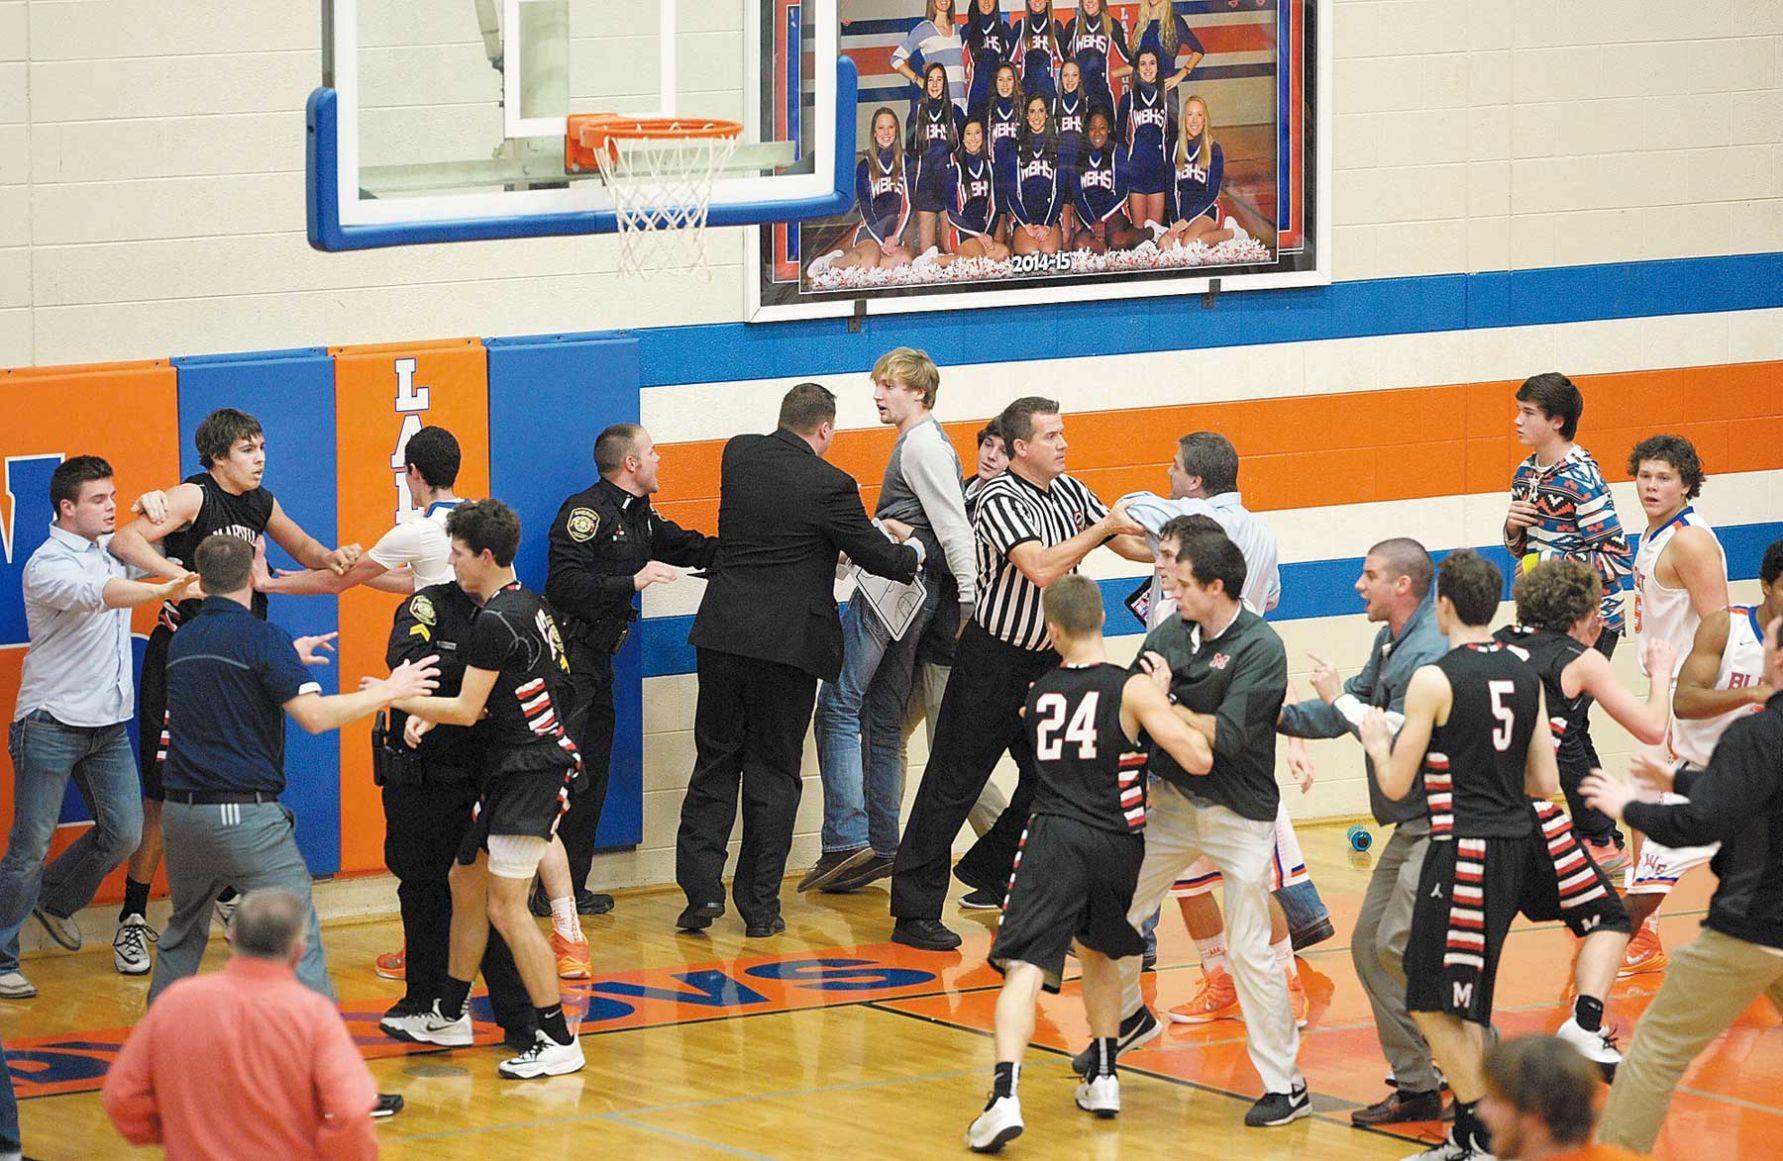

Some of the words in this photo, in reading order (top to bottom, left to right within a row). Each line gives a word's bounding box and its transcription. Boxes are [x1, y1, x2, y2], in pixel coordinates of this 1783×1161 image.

[1076, 34, 1107, 54] WBHS
[1133, 108, 1165, 129] WBHS
[1021, 159, 1053, 181] WBHS
[1080, 170, 1113, 190] WBHS
[1012, 253, 1071, 272] 2014-15
[1488, 679, 1516, 752] 5
[1035, 691, 1100, 762] 24
[1452, 981, 1474, 1009] M
